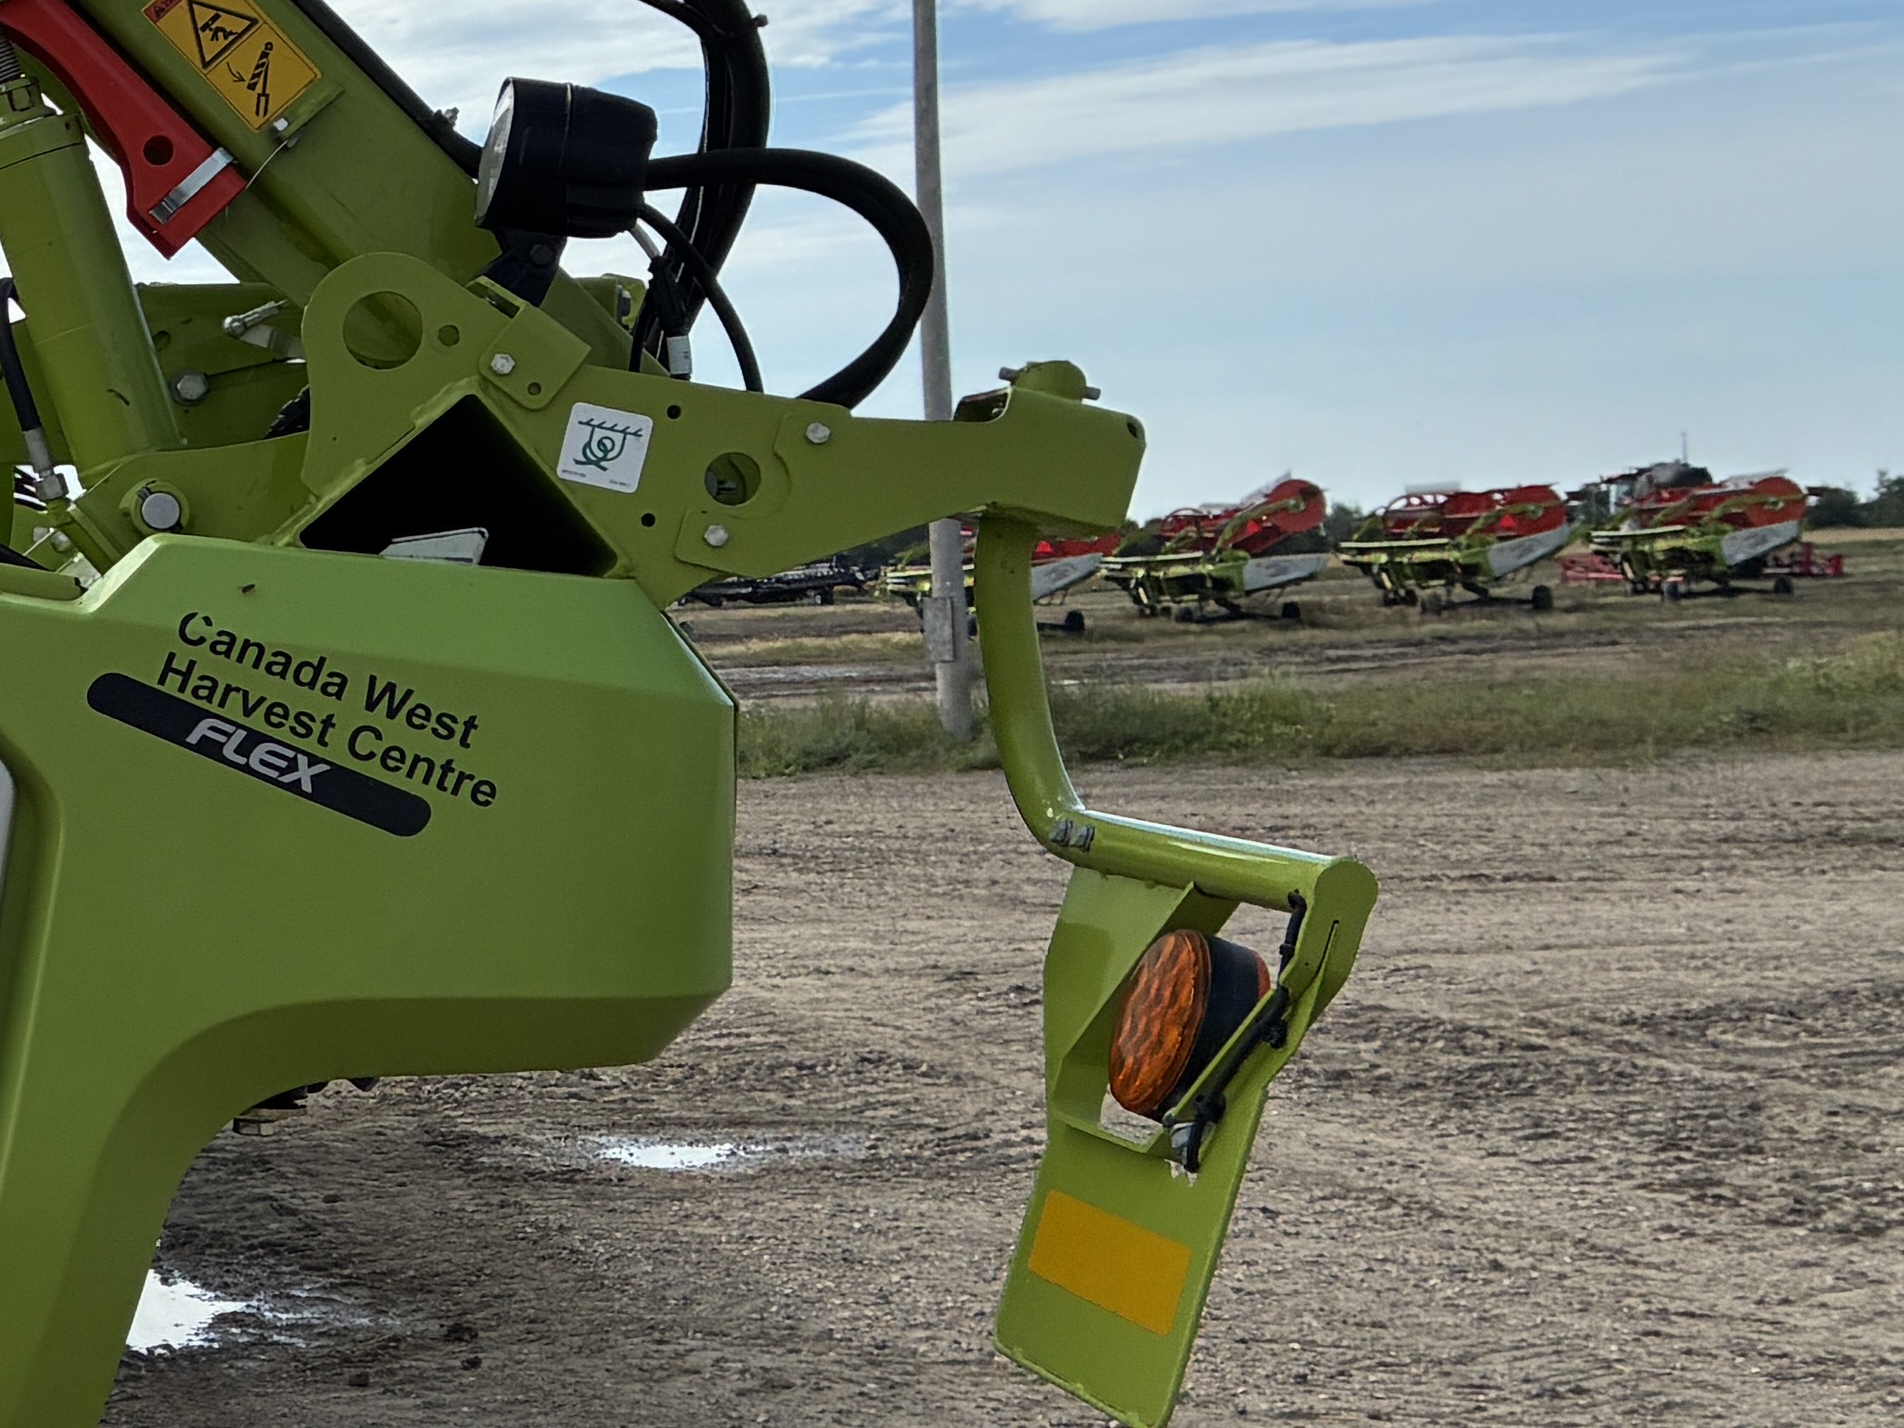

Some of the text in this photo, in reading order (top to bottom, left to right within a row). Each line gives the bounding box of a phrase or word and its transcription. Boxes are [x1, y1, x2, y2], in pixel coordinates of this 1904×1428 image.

[157, 652, 497, 808] Harvest Centre
[178, 612, 479, 749] Canada West
[185, 718, 330, 793] FLEX
